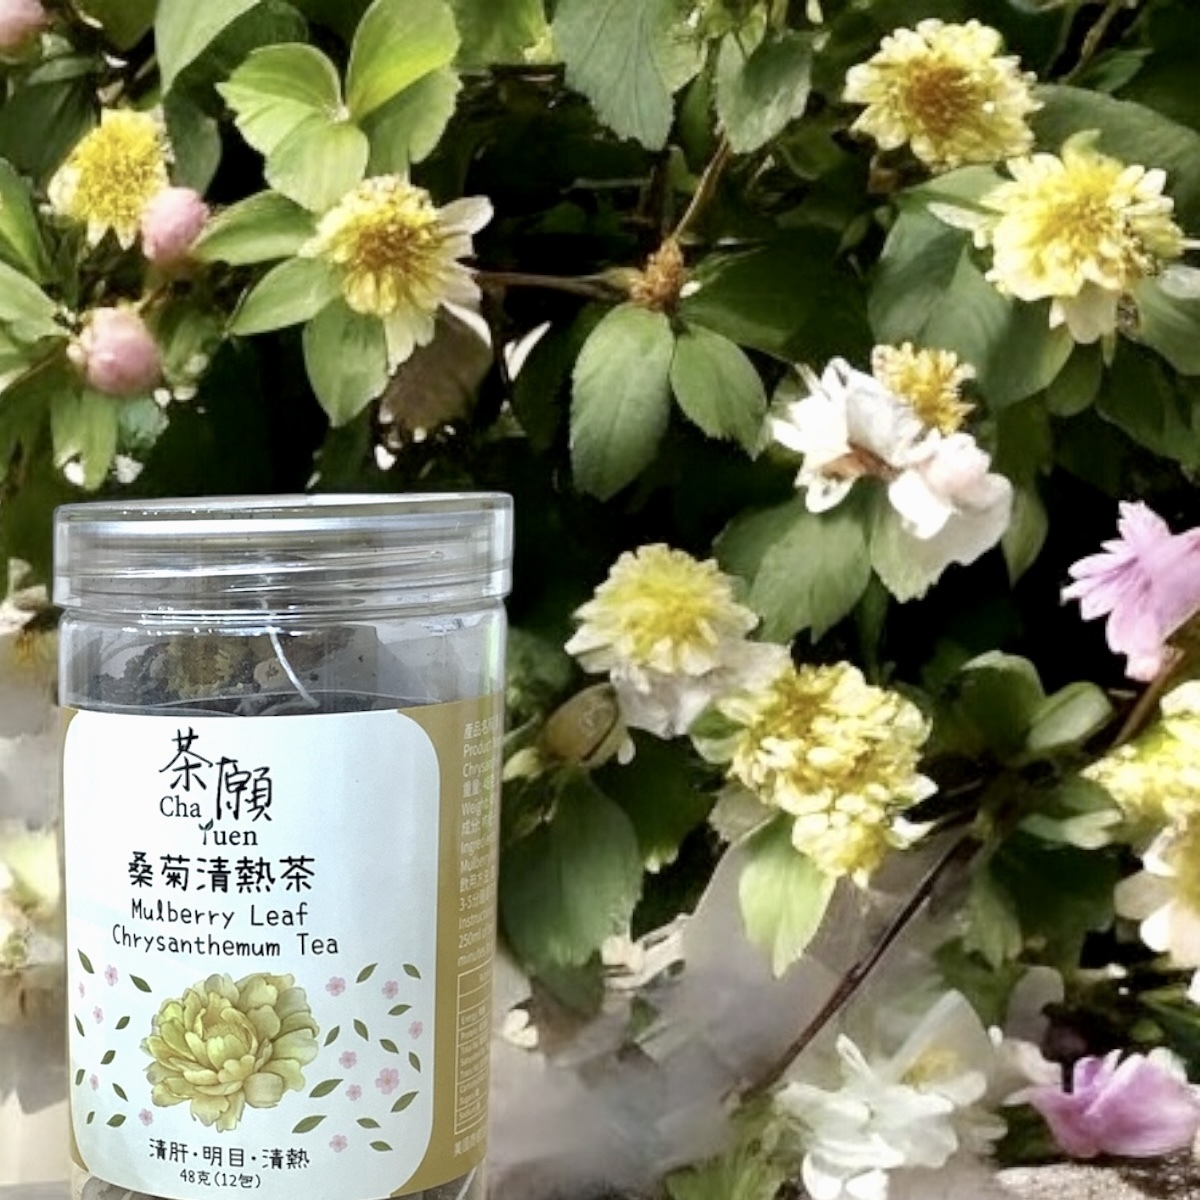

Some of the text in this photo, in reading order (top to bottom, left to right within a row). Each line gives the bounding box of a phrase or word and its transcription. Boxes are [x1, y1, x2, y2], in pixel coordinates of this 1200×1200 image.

[159, 795, 202, 818] Cha
[127, 851, 315, 893] 桑菊清熱茶
[131, 898, 309, 929] Mulberry Leaf
[112, 925, 339, 957] Chrysanthemum Tea
